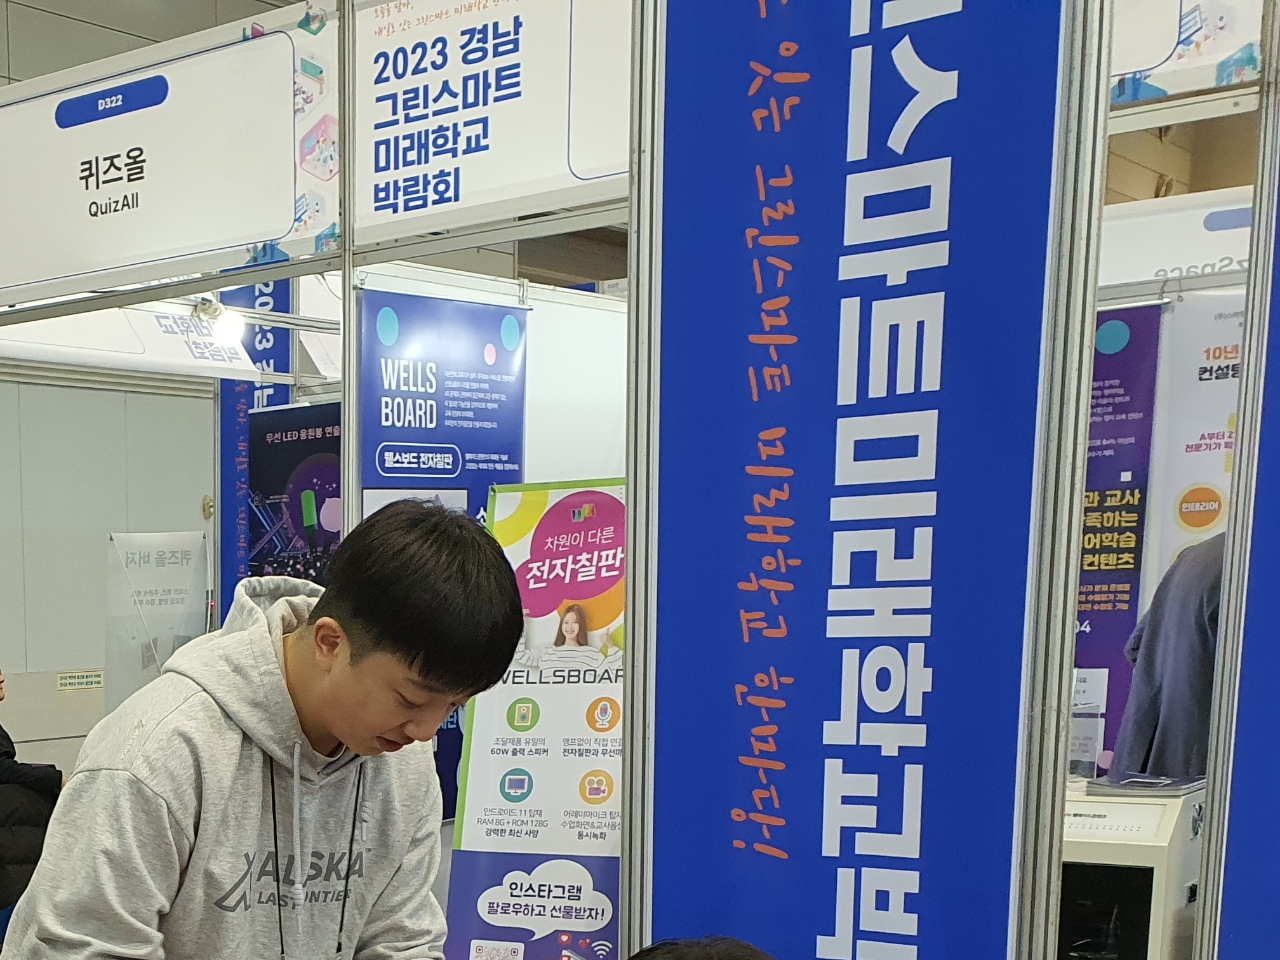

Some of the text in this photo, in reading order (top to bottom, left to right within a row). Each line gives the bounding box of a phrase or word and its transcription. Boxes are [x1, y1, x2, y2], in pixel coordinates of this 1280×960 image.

[373, 14, 523, 85] 2023 경남
[98, 94, 123, 111] D322
[373, 62, 522, 131] 그린스마트
[373, 116, 490, 173] 미래학교
[79, 147, 147, 191] 퀴즈올
[373, 167, 460, 214] 박람회
[88, 192, 139, 218] QuizAll
[746, 164, 800, 402] 그린스마트
[380, 358, 437, 393] WELLS
[381, 396, 437, 429] BOARD
[282, 431, 298, 442] LED
[384, 452, 418, 468] 웰스보드
[420, 453, 453, 469] 전자칠판
[1103, 489, 1141, 507] 교사
[1083, 510, 1139, 528] 족하는
[544, 526, 615, 552] 차원이 다른
[737, 426, 801, 642] 미래학교
[1081, 531, 1137, 549] 어학습
[525, 547, 625, 589] 전자칠판
[490, 748, 509, 756] 60W
[527, 748, 549, 757] 스피커
[562, 748, 599, 757] 전자칠판과
[483, 808, 518, 817] 안드로이드
[477, 818, 494, 826] RAM
[511, 819, 529, 827] ROM
[530, 819, 549, 828] 128G
[485, 828, 506, 837] 강력한
[508, 828, 523, 837] 최신
[509, 882, 583, 901] 인스타그램
[487, 901, 605, 921] 팔로우하고 선물받자!
